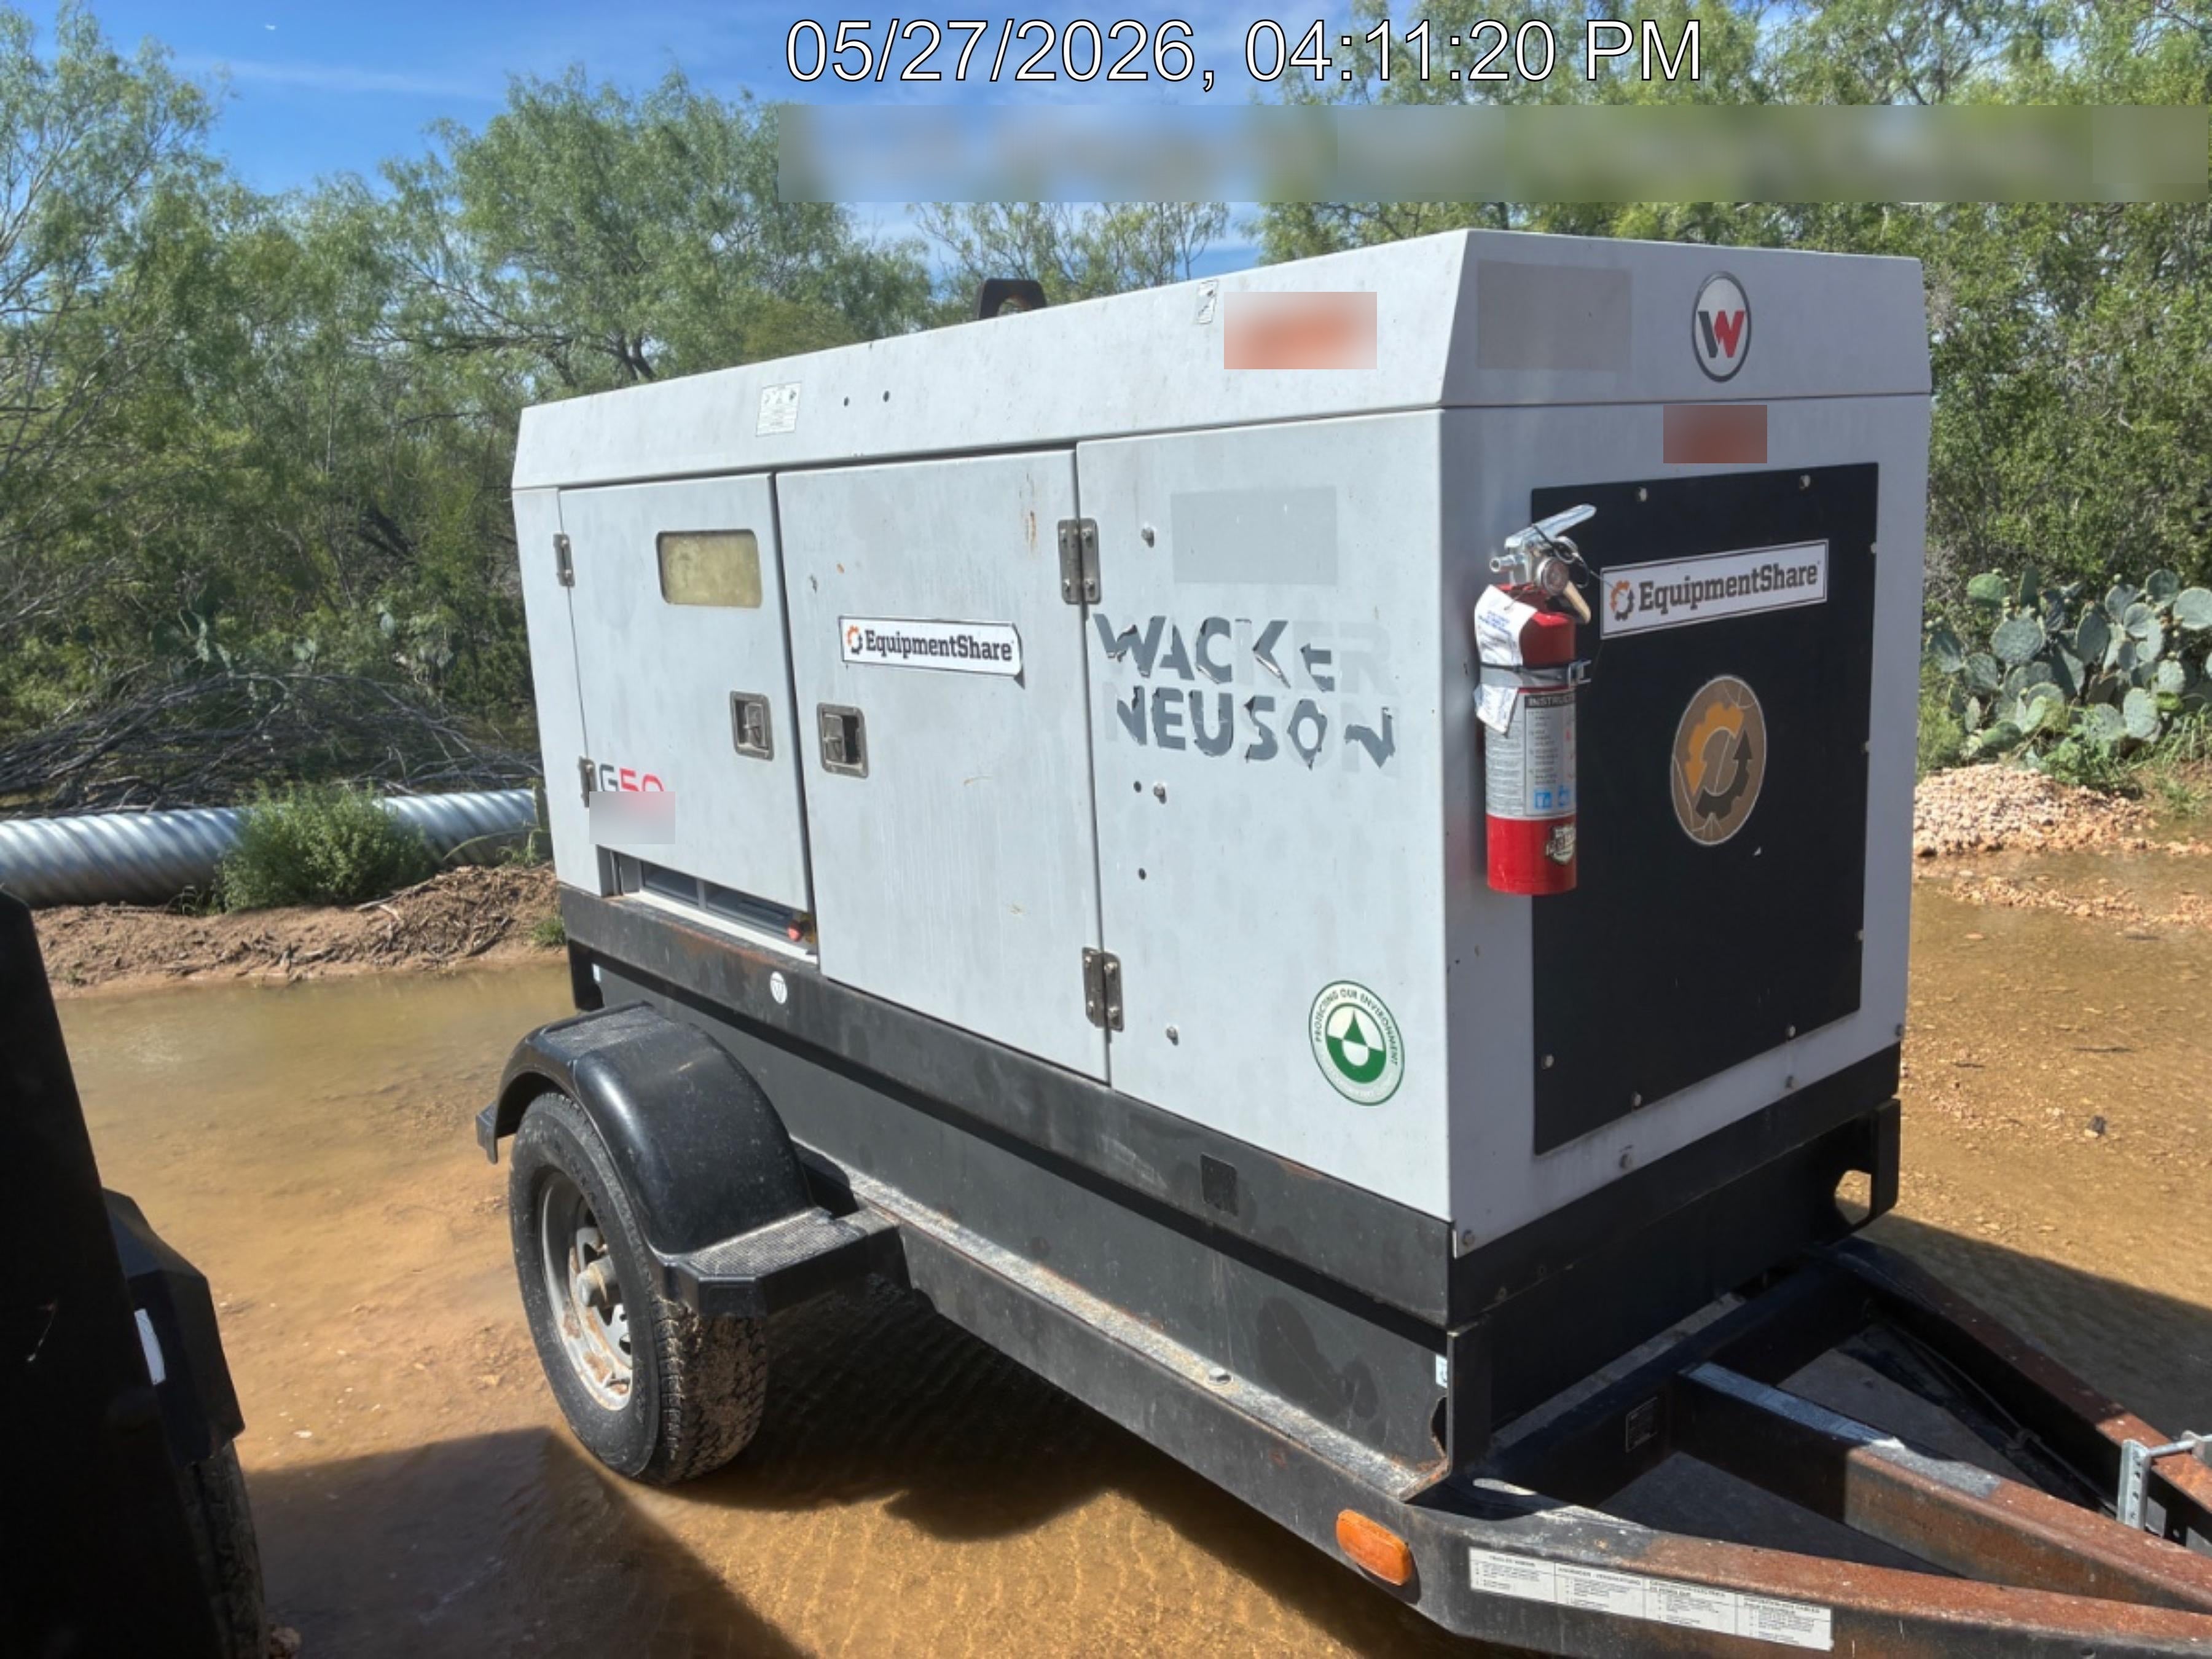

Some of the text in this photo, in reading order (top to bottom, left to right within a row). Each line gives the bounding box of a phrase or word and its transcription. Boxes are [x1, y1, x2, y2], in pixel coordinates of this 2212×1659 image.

[1638, 561, 1818, 615] EquipmentShare
[865, 629, 1013, 662] EquipmentShare
[1104, 681, 1400, 777] NEUSON
[1339, 988, 1358, 1000] OUR
[1360, 992, 1398, 1067] ENVIRONMENT
